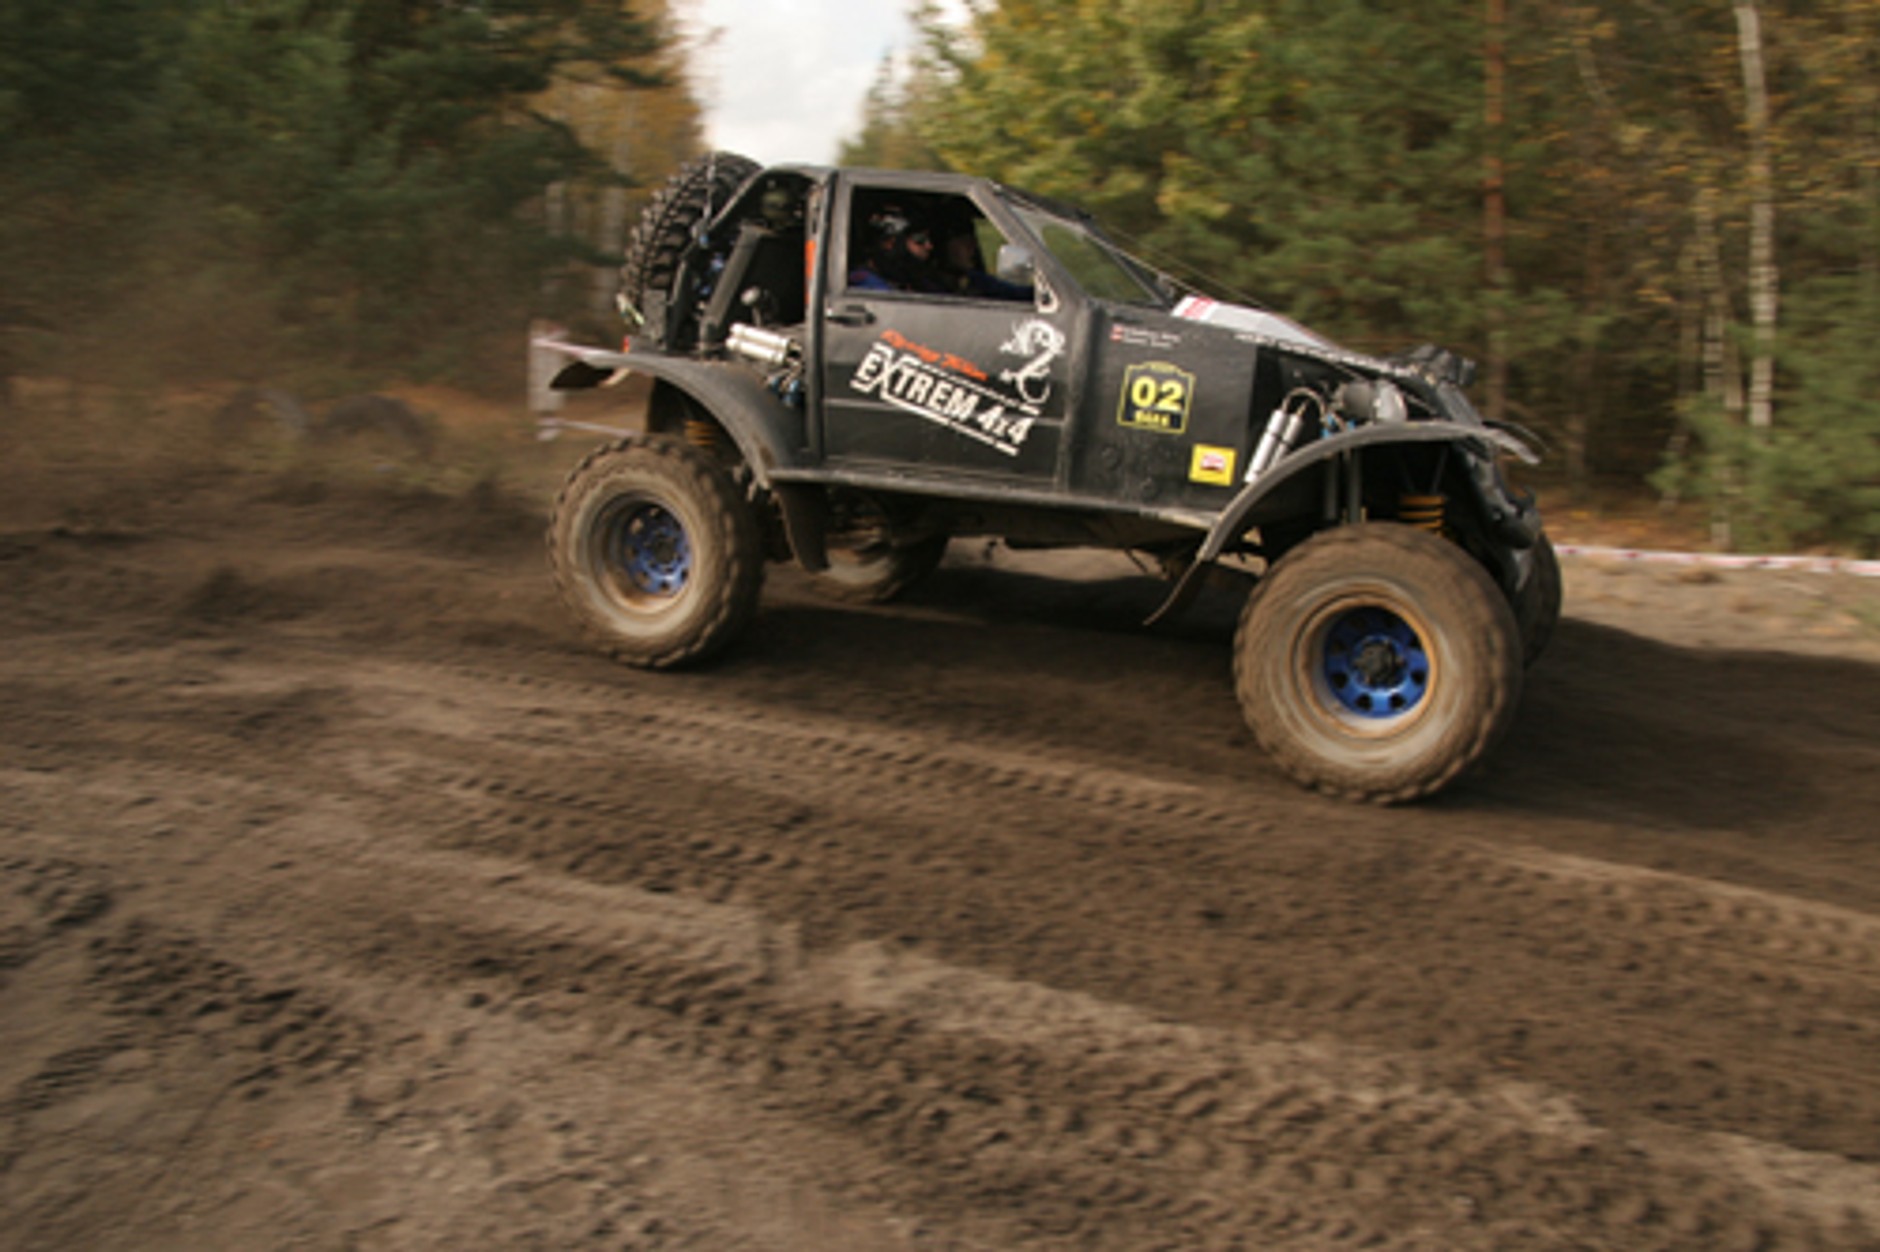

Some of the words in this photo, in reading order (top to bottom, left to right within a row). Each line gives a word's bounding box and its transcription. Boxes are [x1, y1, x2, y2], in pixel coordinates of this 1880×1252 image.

[852, 346, 980, 421] EXTREM
[977, 405, 1036, 445] 4x4
[1131, 376, 1184, 411] 02
